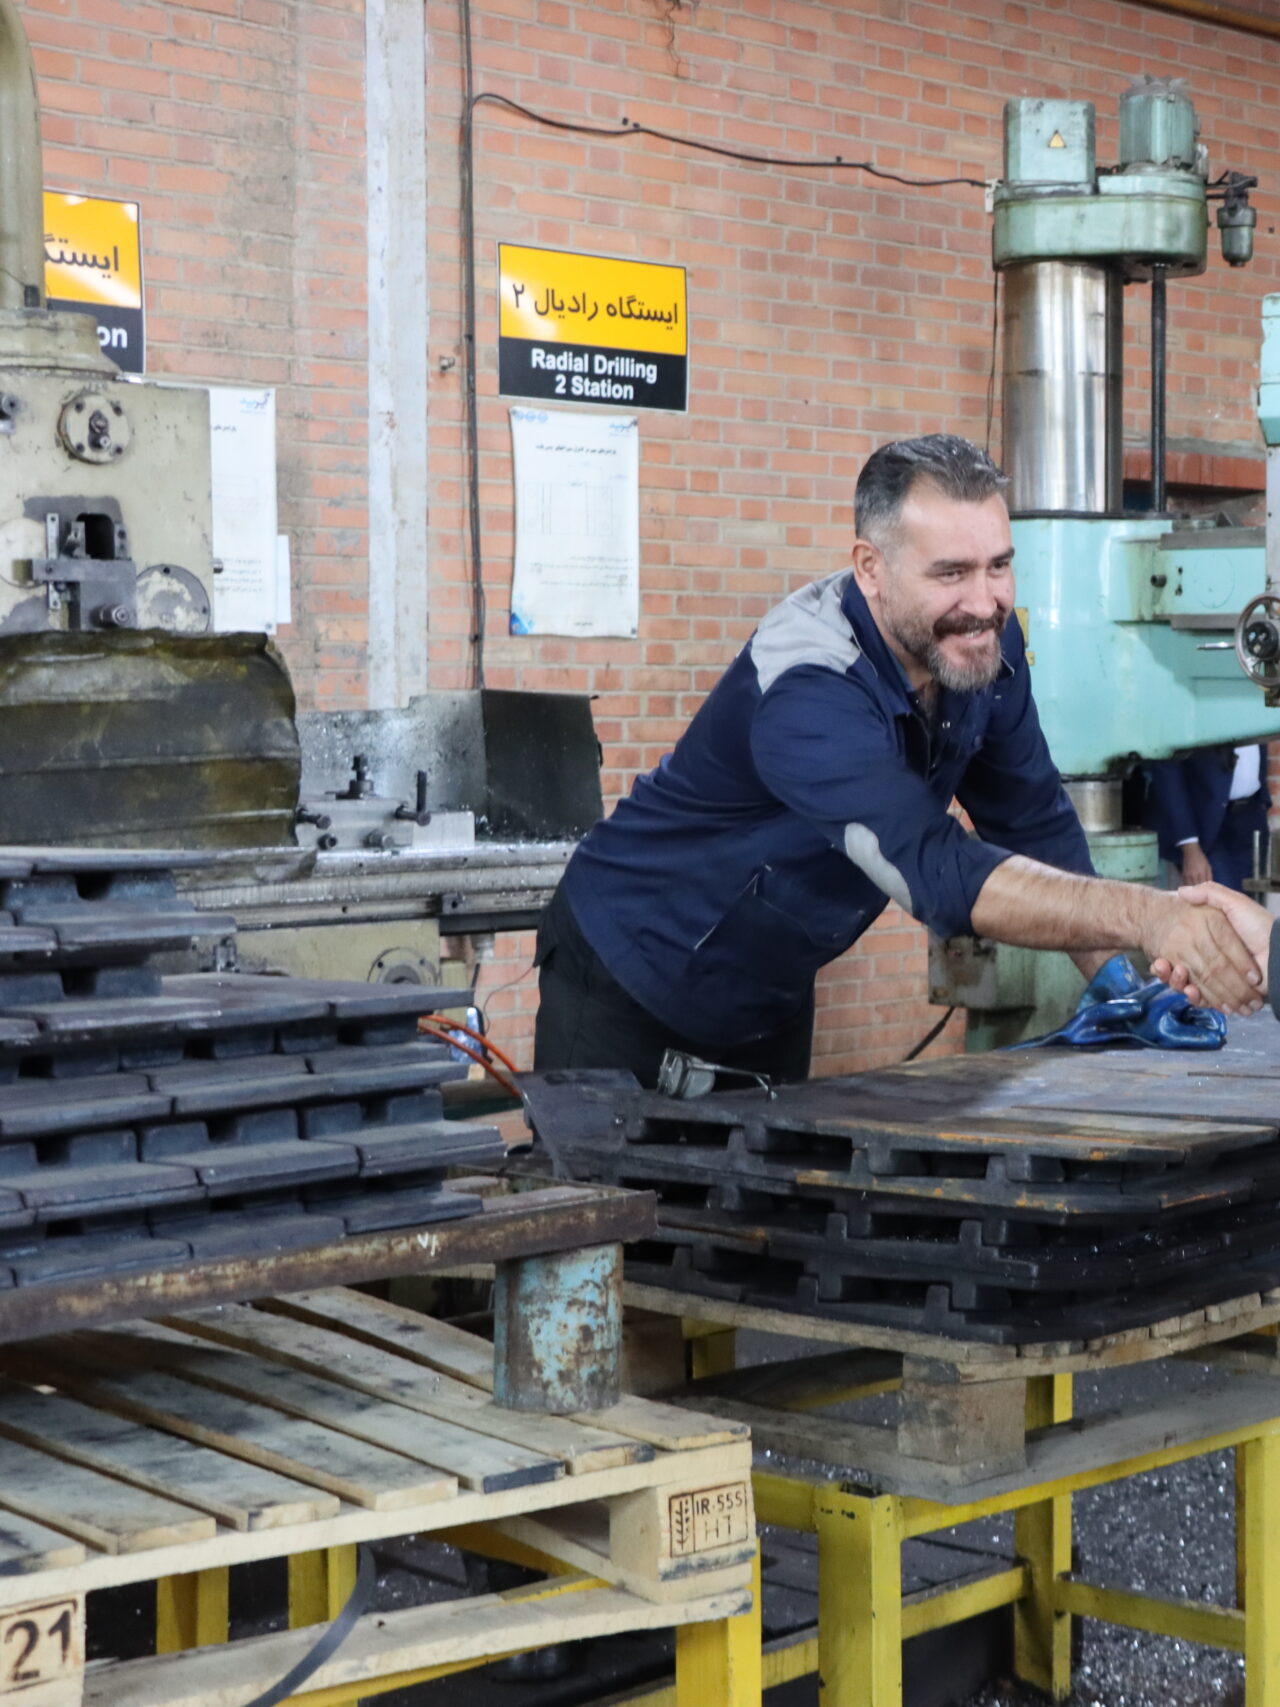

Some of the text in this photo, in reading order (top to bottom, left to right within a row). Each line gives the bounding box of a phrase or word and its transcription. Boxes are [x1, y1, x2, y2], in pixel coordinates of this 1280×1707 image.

[512, 283, 678, 330] ایستگاه رادیال ۲
[531, 348, 658, 384] Radial Drilling
[555, 374, 634, 400] 2 Station
[704, 1515, 731, 1542] HT
[4, 1609, 71, 1682] 21
